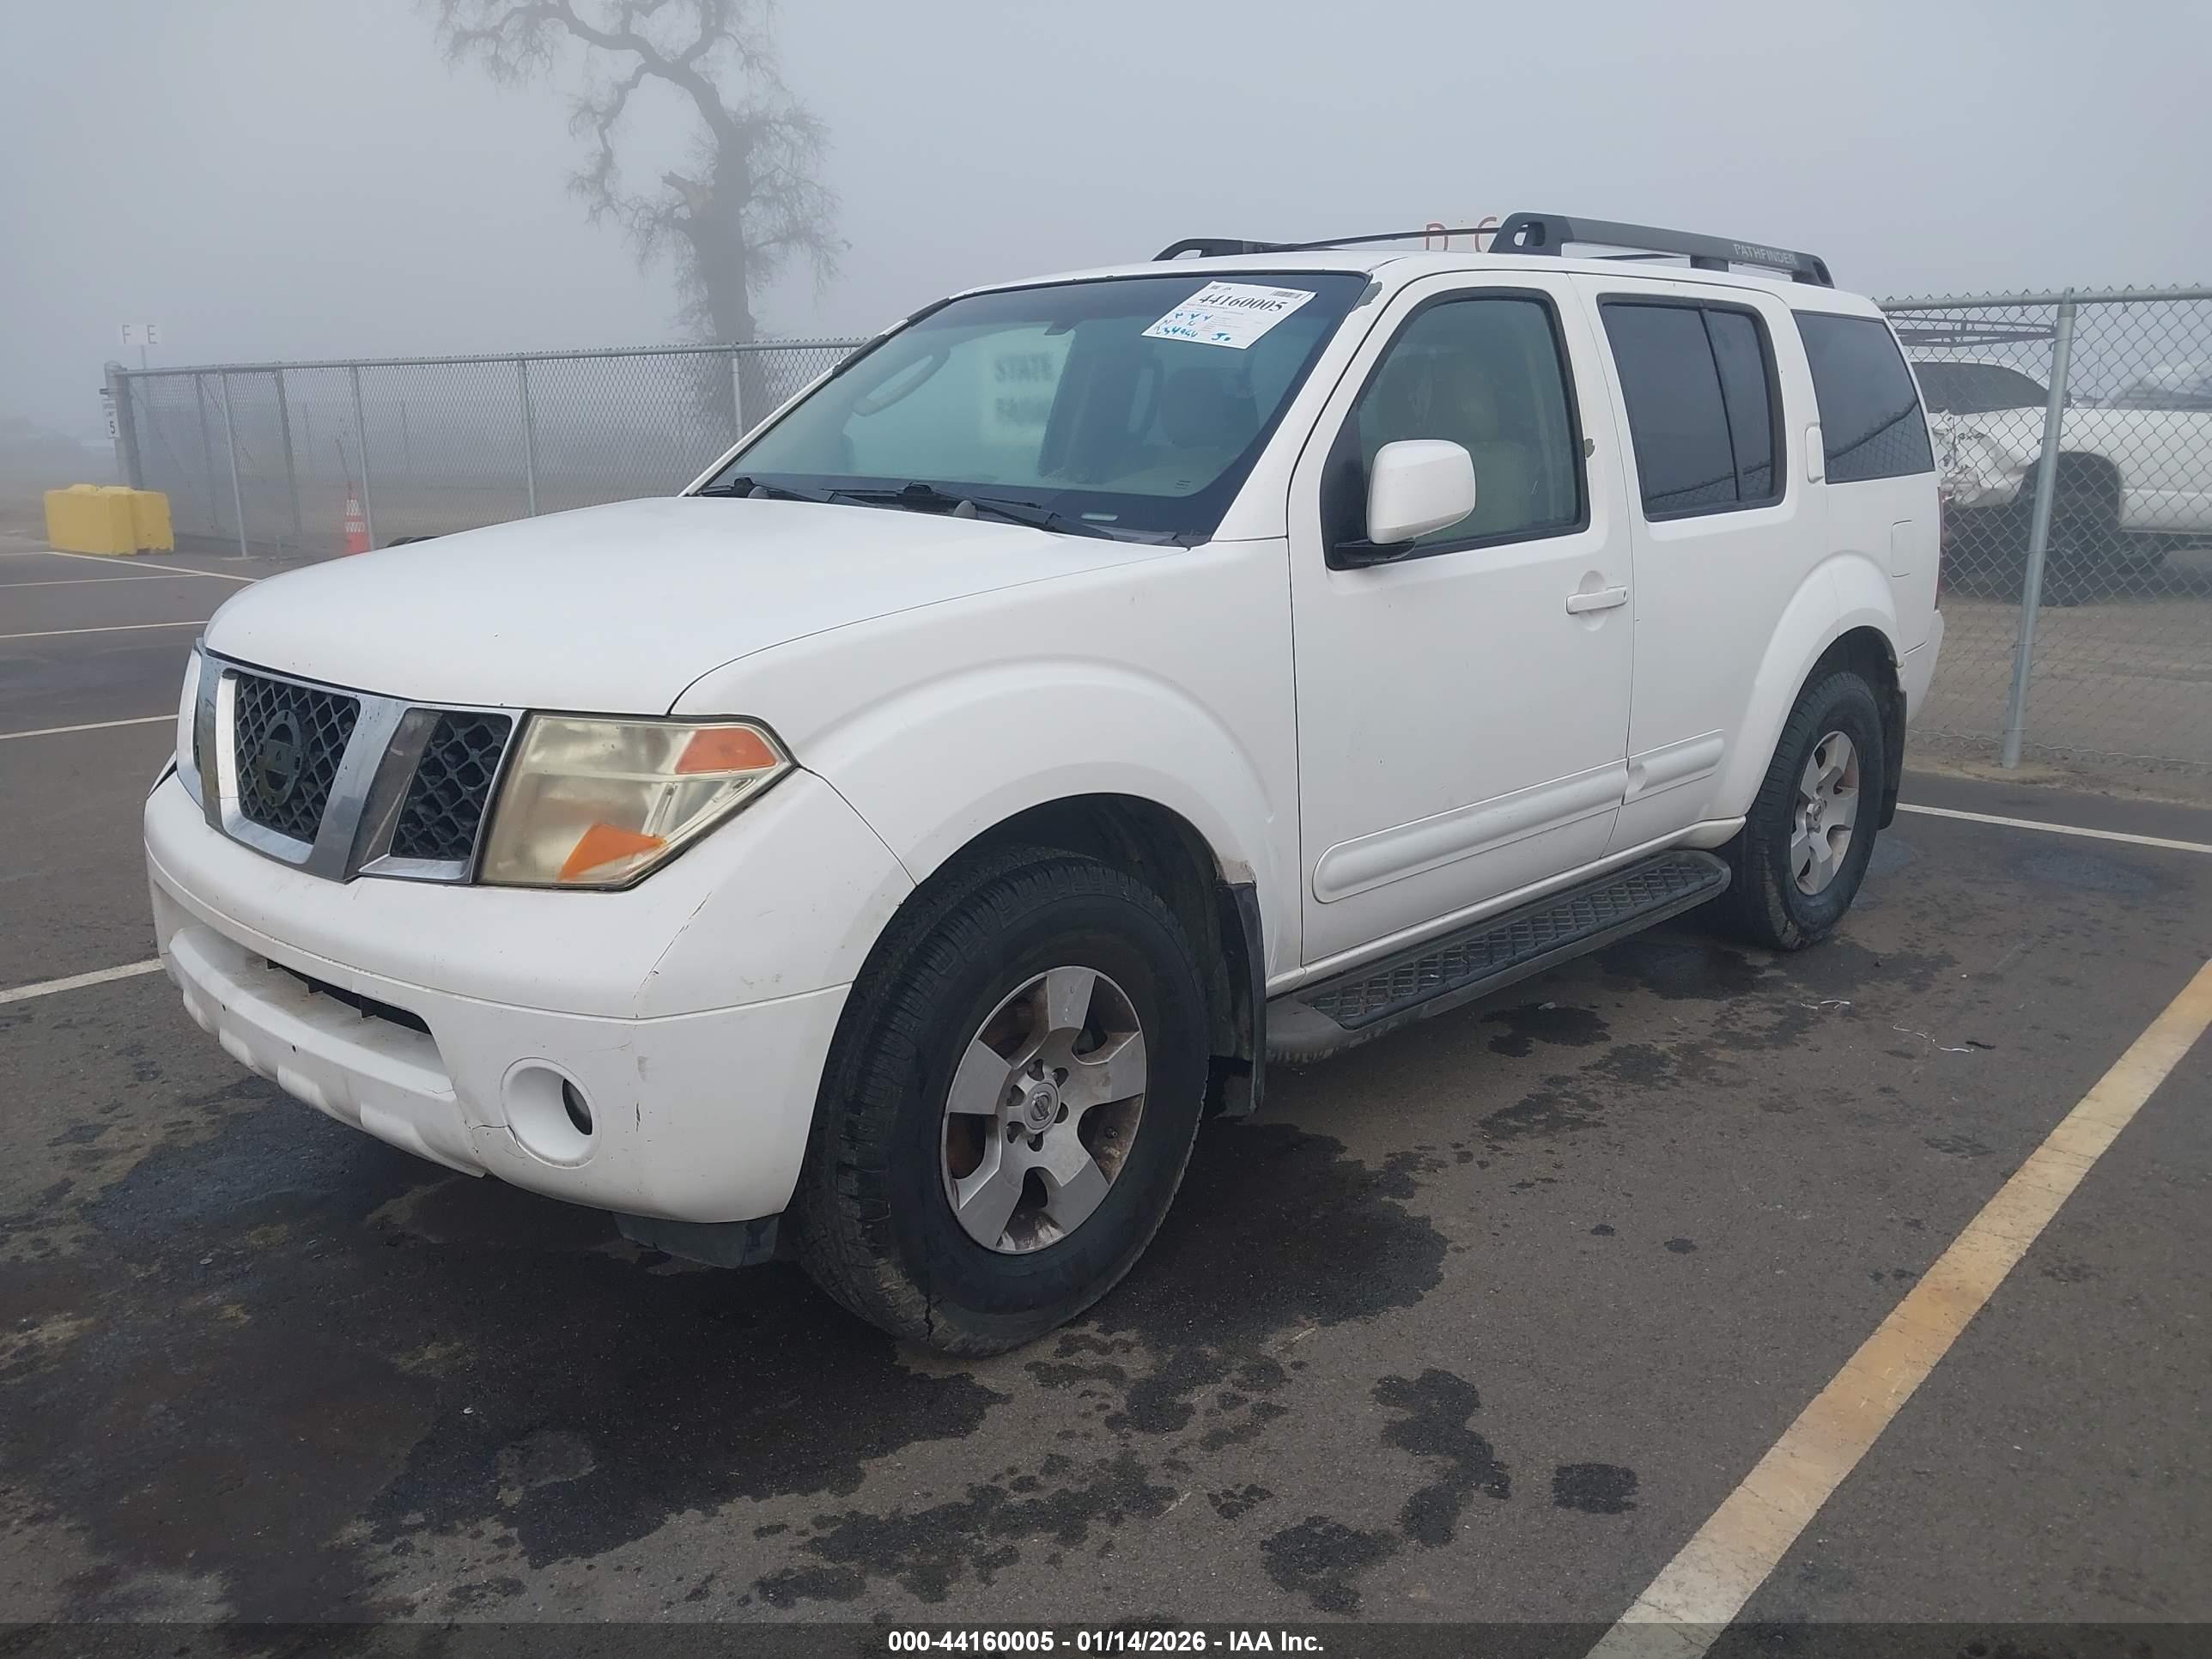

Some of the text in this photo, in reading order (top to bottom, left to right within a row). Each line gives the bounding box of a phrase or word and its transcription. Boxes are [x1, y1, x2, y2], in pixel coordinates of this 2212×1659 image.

[1733, 244, 1798, 265] PATHFINDER
[1199, 294, 1288, 313] 44160005
[122, 325, 157, 344] F E
[109, 420, 116, 434] 5
